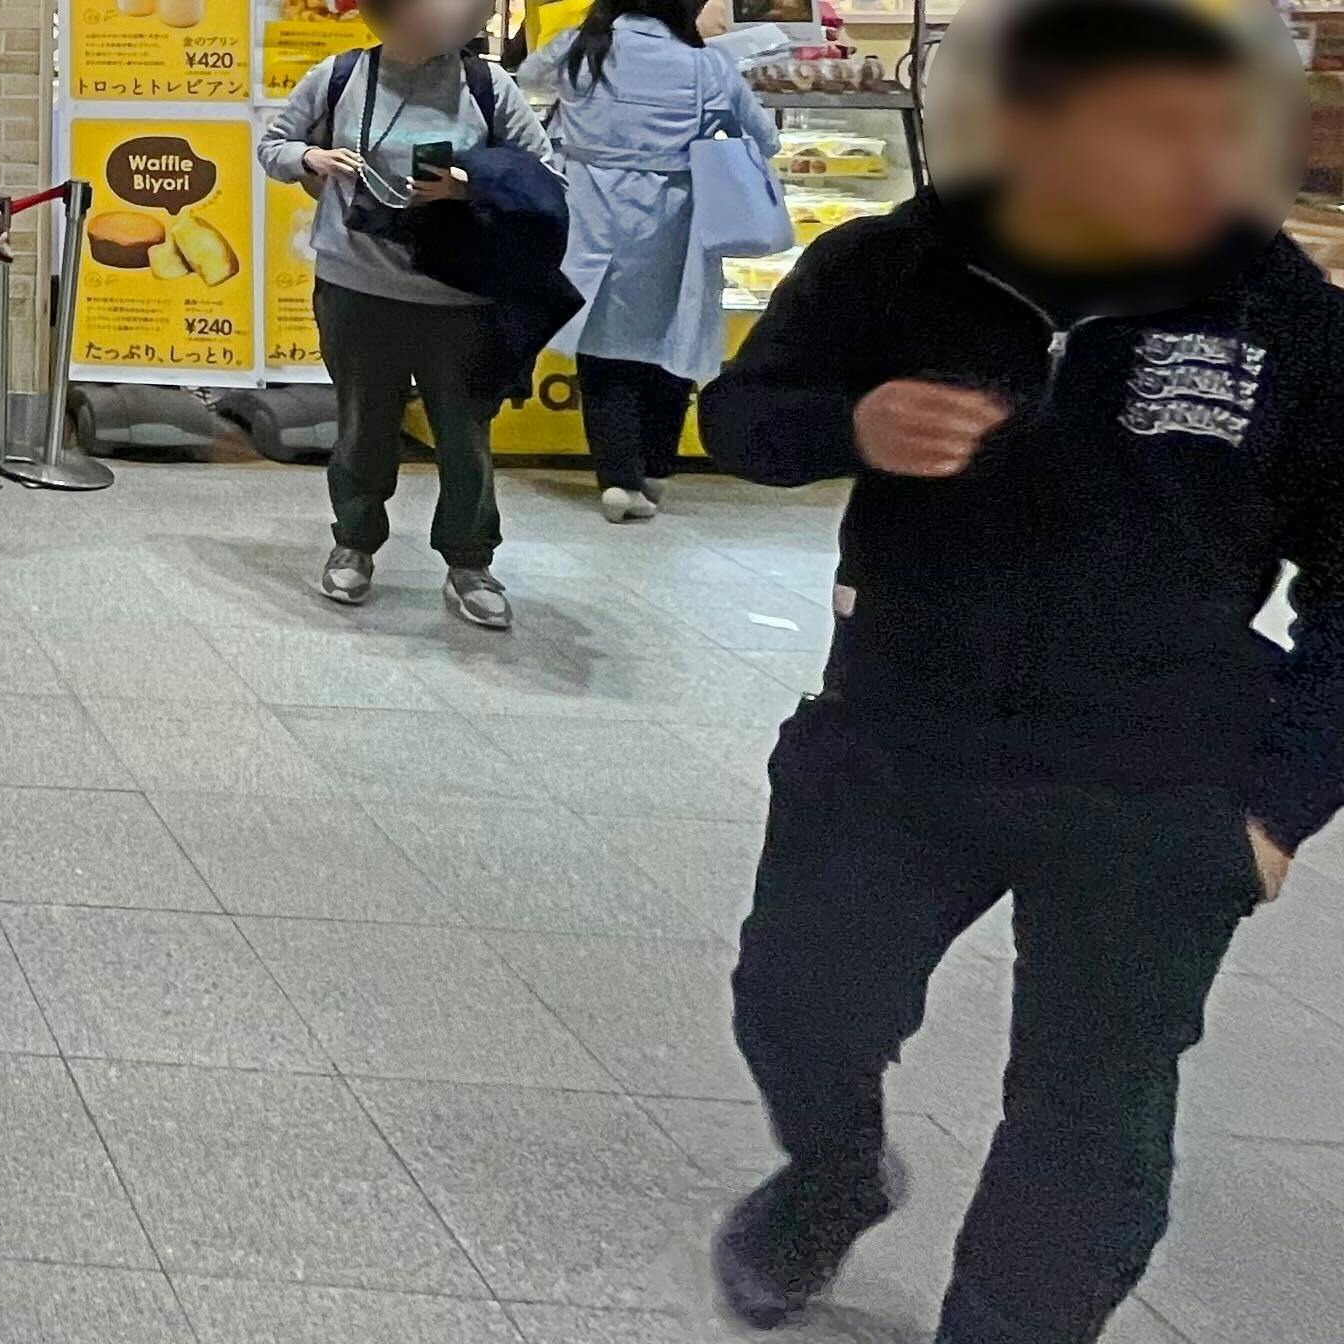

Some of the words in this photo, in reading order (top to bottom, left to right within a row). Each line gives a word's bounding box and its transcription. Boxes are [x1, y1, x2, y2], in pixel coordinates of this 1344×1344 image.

[185, 52, 234, 69] ¥420
[128, 155, 193, 172] Waffle
[133, 174, 190, 194] Biyori
[184, 318, 233, 336] ¥240
[85, 341, 242, 366] たっぷり、しっとり。
